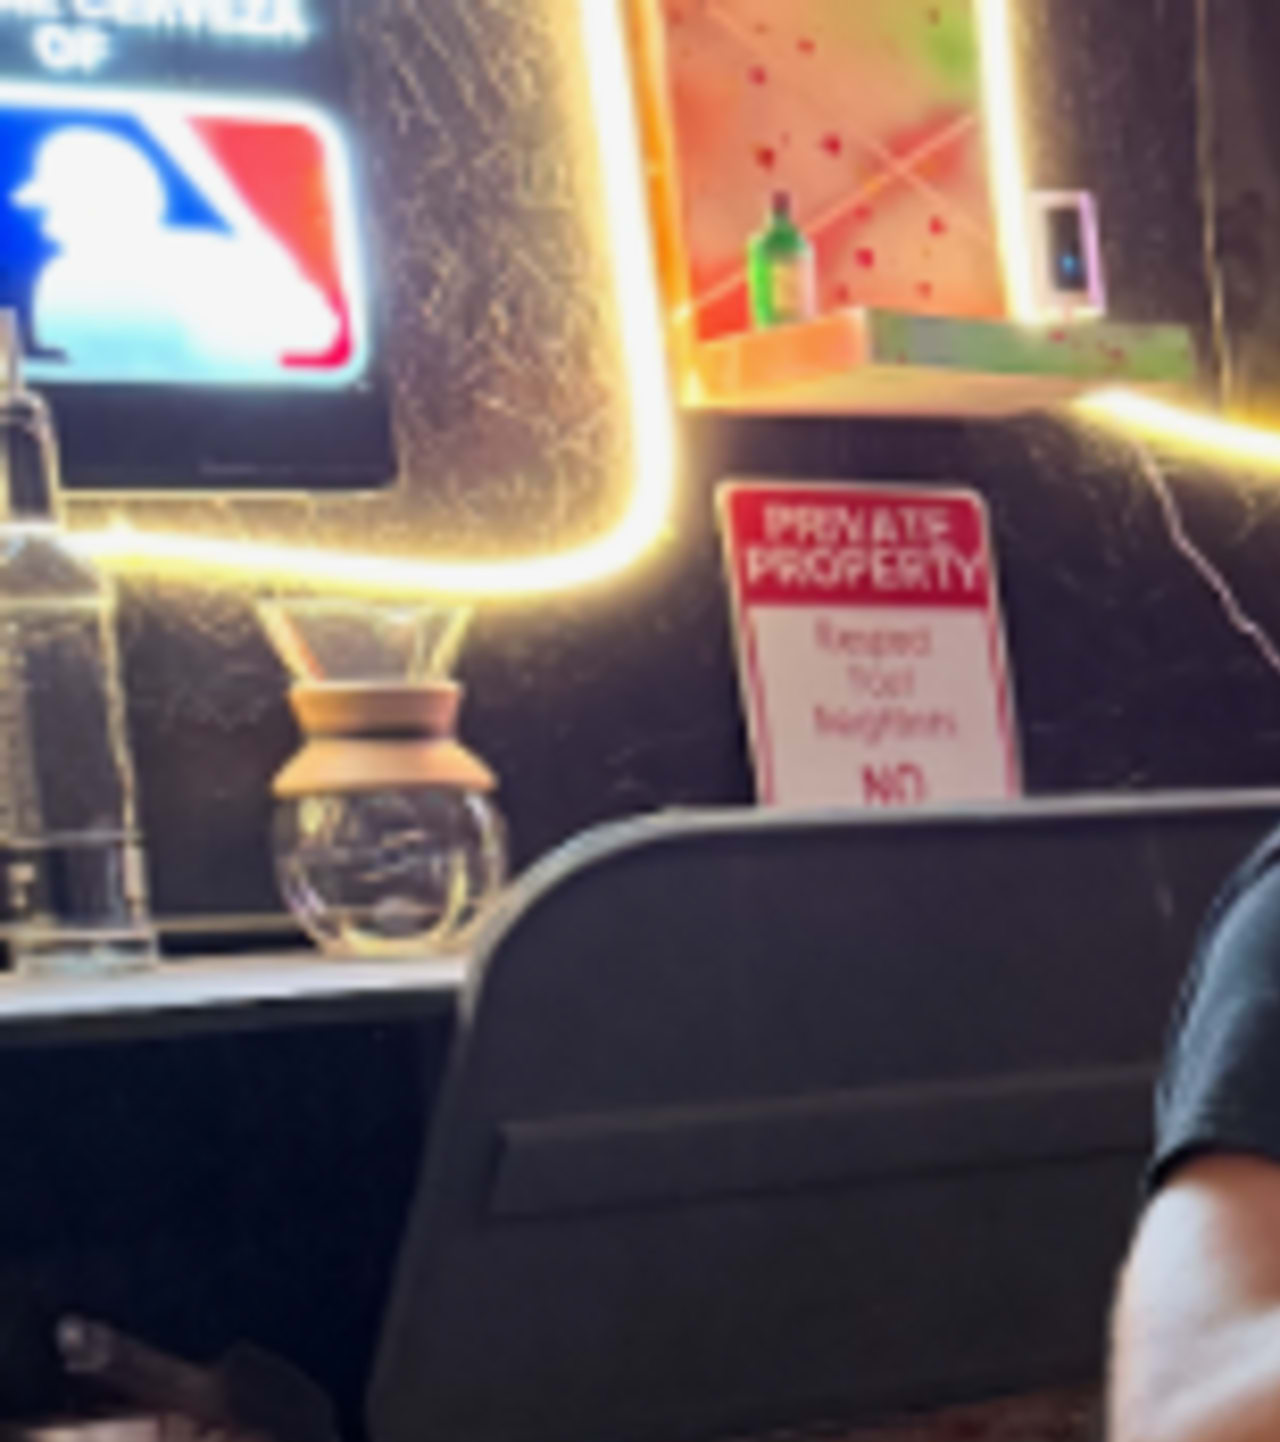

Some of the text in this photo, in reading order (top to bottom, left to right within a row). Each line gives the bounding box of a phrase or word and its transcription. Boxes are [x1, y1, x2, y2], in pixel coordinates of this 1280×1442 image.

[32, 21, 110, 71] OF
[763, 503, 952, 543] PRIVATE
[747, 546, 985, 592] PROPERTY
[861, 762, 927, 807] NO
